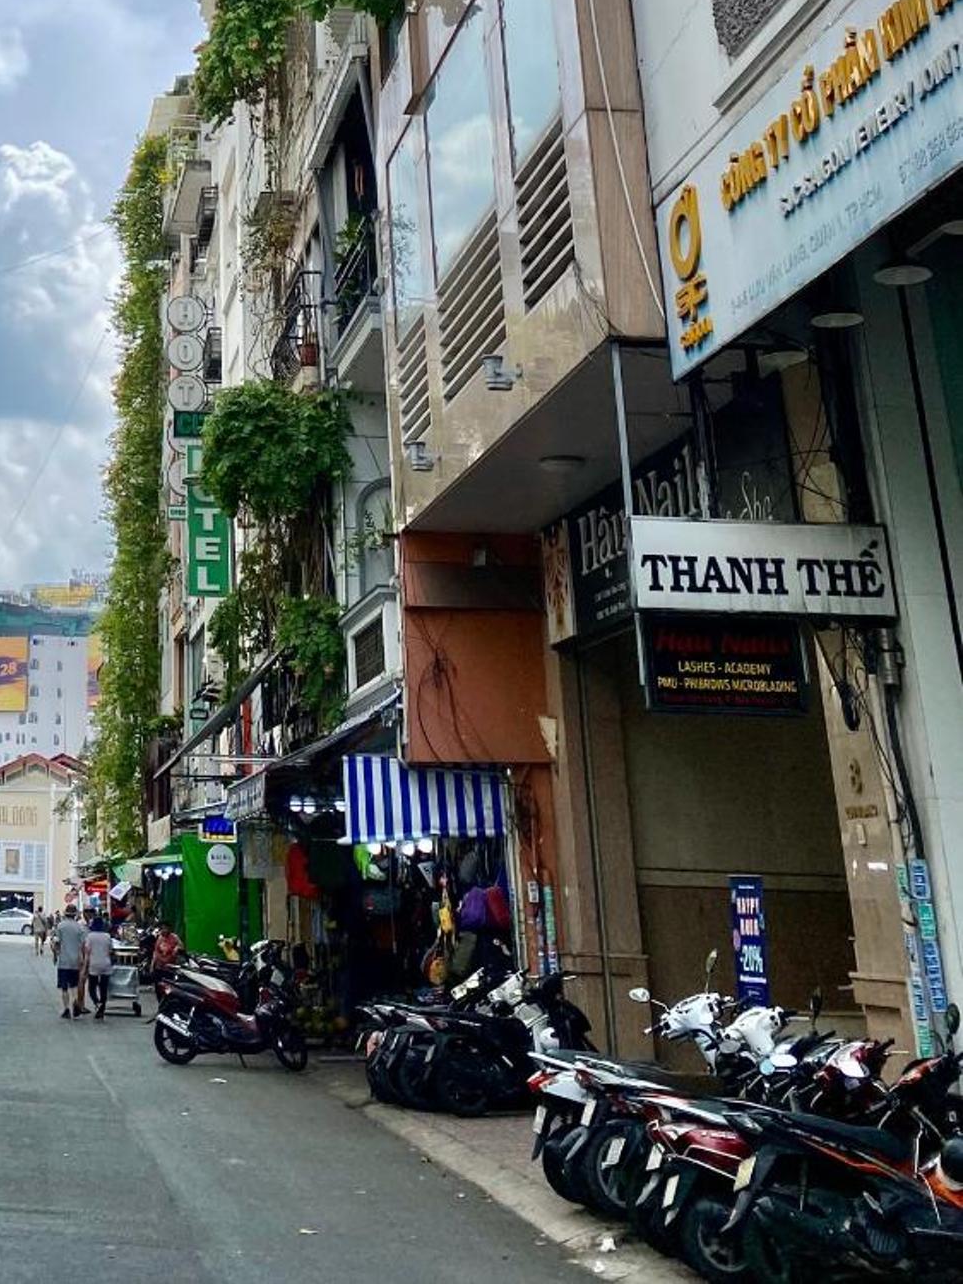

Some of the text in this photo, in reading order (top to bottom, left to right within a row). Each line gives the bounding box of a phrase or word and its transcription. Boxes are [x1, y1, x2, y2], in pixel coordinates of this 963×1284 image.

[640, 554, 789, 596] THANH
[796, 539, 886, 598] THẾ
[0, 661, 18, 676] 28
[678, 660, 773, 675] LASHES ACADEMY
